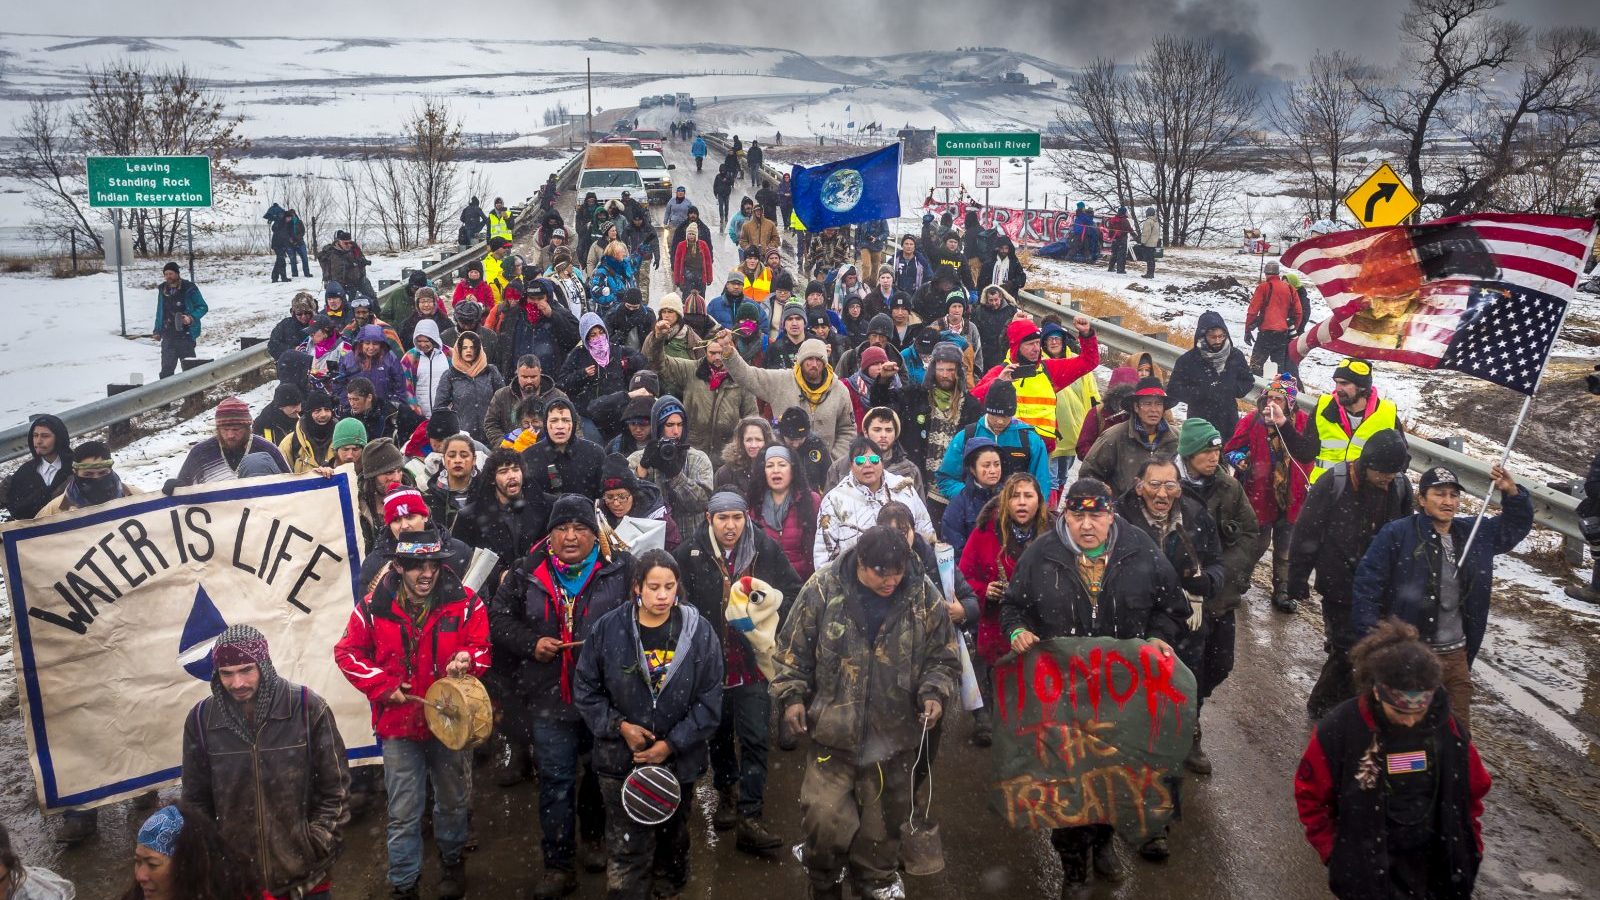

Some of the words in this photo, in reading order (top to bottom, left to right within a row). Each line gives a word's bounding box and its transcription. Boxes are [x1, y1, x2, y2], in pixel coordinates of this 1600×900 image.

[945, 140, 1001, 149] Cannonball
[1004, 140, 1031, 149] River
[126, 162, 170, 174] Leaving
[943, 159, 952, 167] NO
[983, 159, 992, 167] NO
[108, 177, 157, 189] Standing
[162, 177, 191, 187] Rock
[97, 191, 129, 202] Indian
[135, 192, 203, 203] Reservation
[396, 503, 409, 516] N
[28, 518, 170, 635] WATER
[170, 506, 216, 565] IS
[232, 507, 344, 615] LIFE
[994, 645, 1189, 727] HONOR
[1015, 718, 1120, 770] THE
